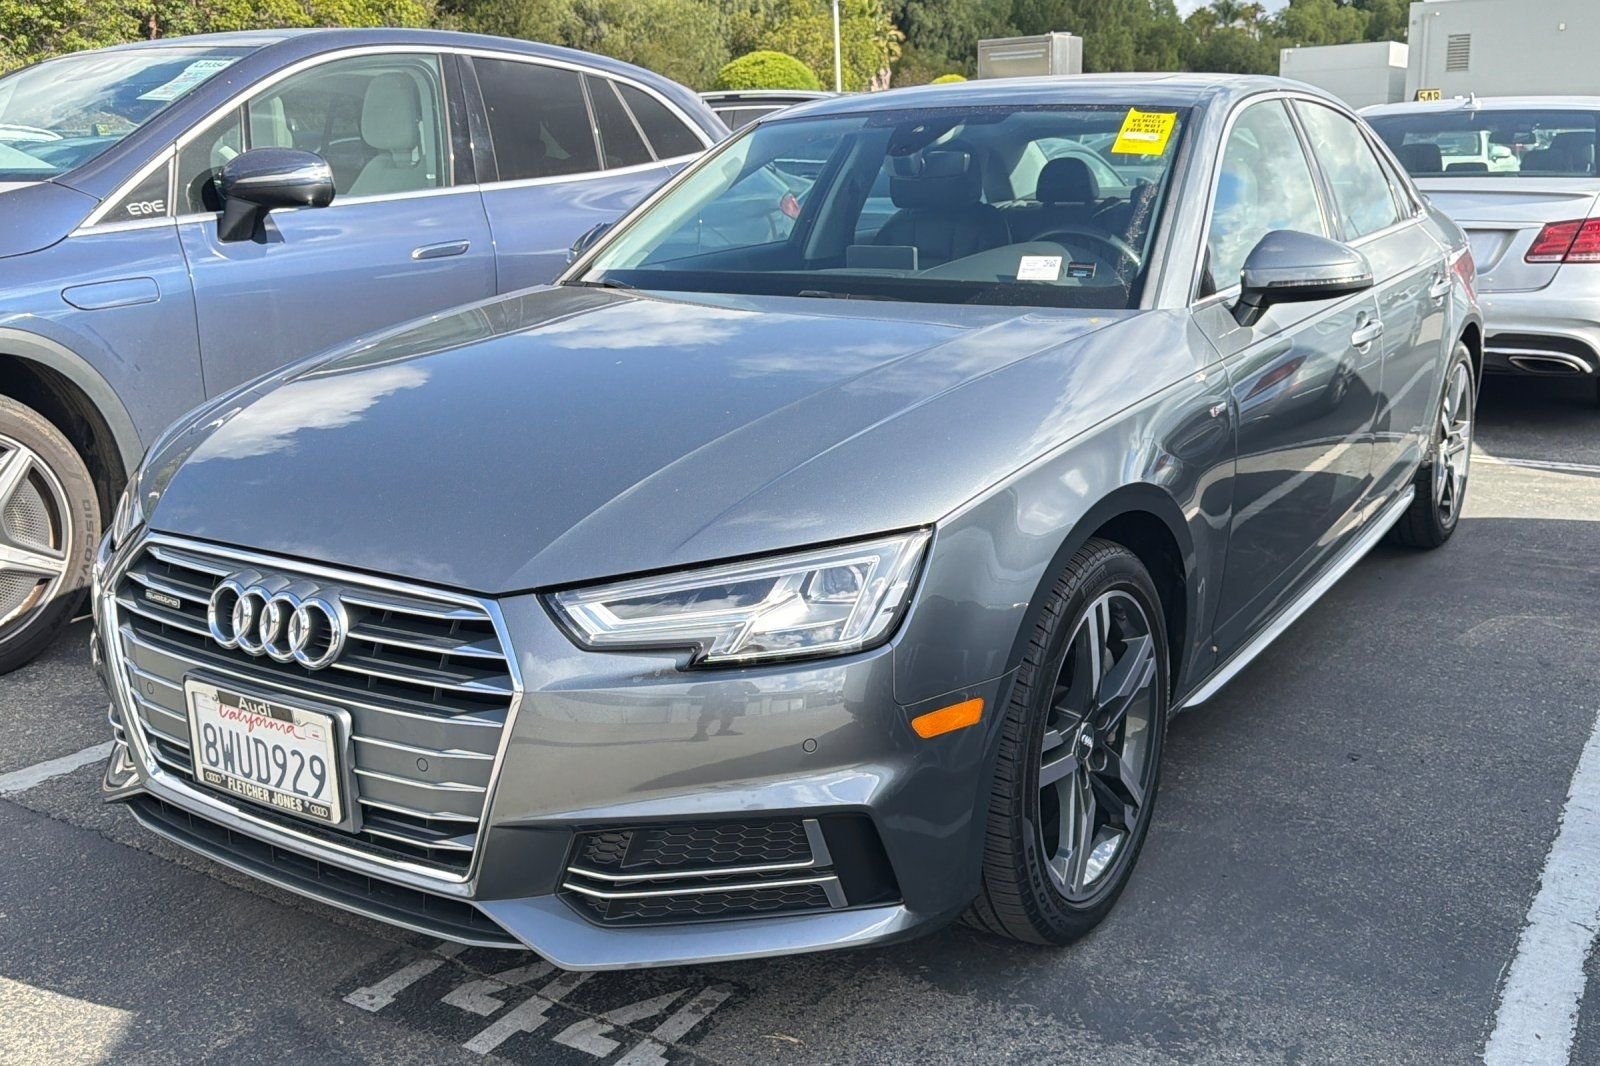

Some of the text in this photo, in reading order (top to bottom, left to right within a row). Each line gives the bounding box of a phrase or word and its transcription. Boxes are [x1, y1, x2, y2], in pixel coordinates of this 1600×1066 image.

[126, 200, 166, 216] EQE
[218, 703, 306, 740] California
[238, 696, 273, 717] Audi
[203, 722, 326, 799] 8WUD929
[227, 777, 304, 812] FLETCHER JONES
